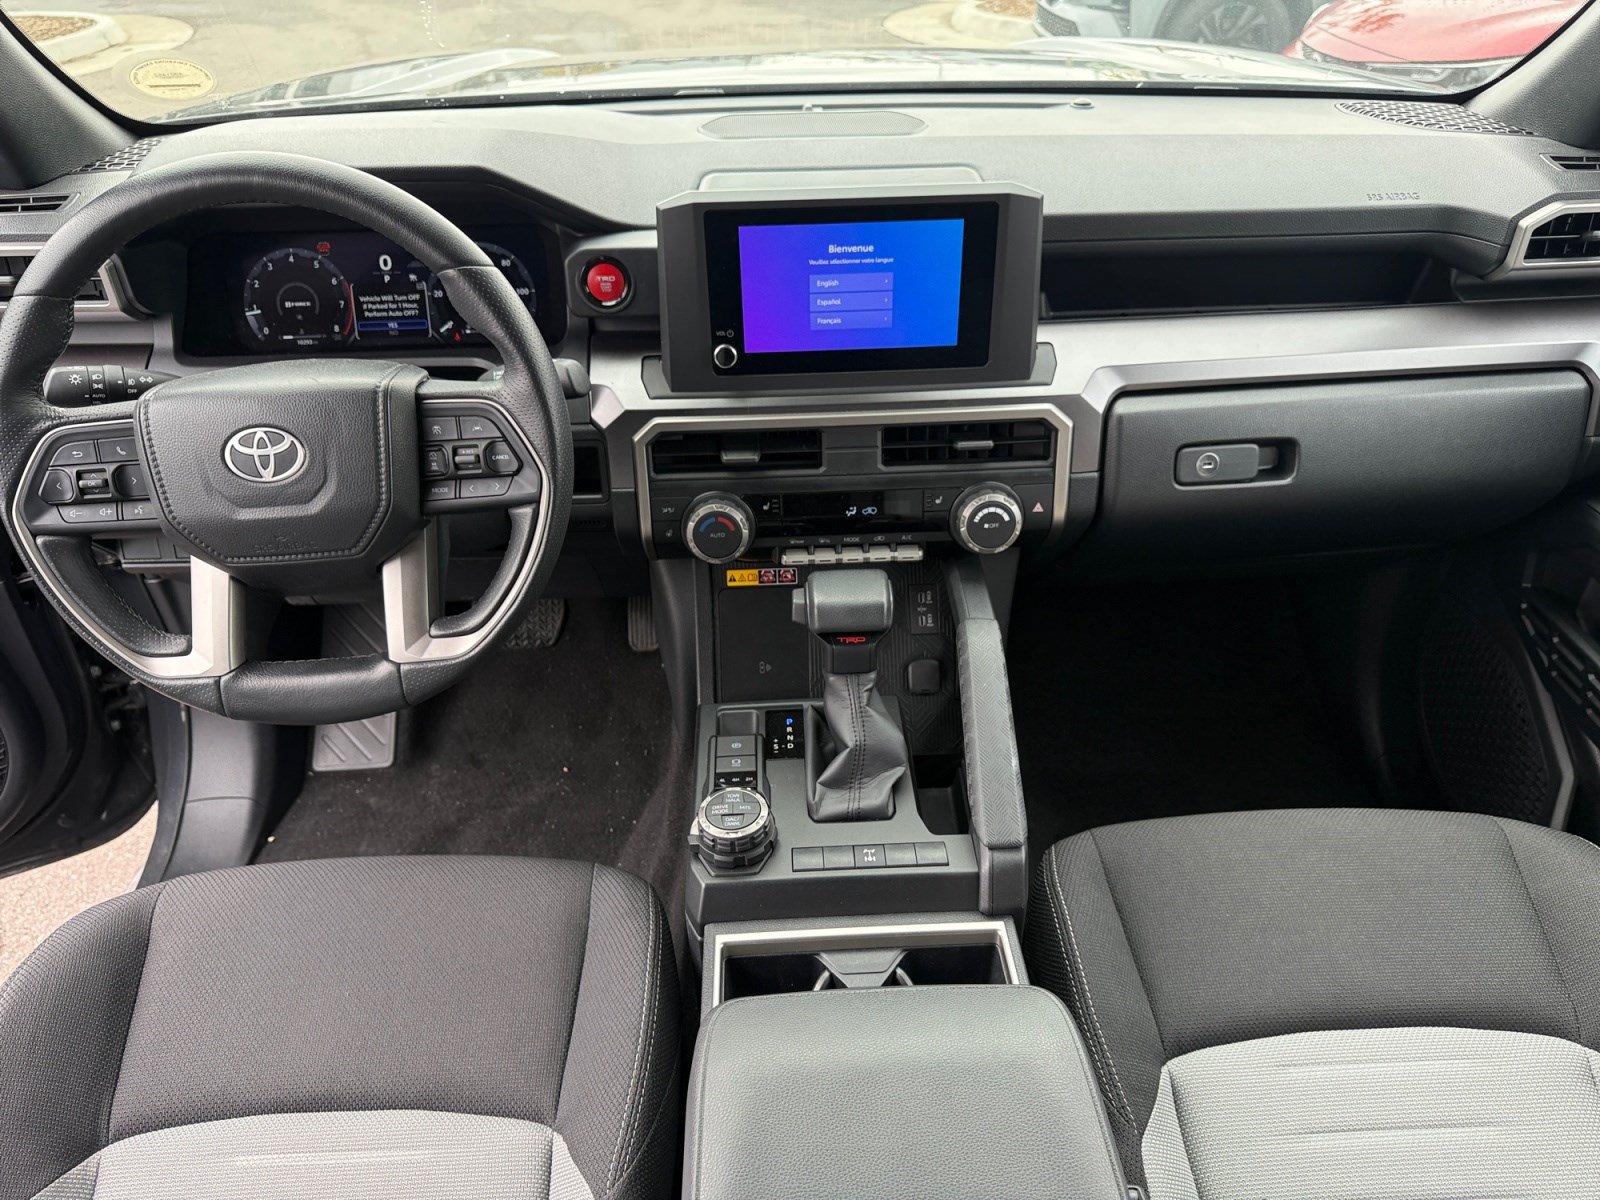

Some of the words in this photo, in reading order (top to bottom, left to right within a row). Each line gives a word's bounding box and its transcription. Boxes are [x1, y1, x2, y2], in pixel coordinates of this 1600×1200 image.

[828, 244, 875, 254] Bienvenue
[289, 254, 294, 263] 4
[379, 254, 392, 271] 0
[267, 263, 273, 271] 3
[314, 260, 320, 269] 5
[501, 259, 511, 267] 80
[332, 277, 338, 286] 6
[384, 275, 390, 283] P
[254, 280, 259, 288] 2
[816, 280, 839, 288] English
[433, 290, 443, 298] 20
[339, 300, 344, 309] 7
[816, 298, 841, 306] Español
[817, 317, 842, 325] Français
[263, 327, 269, 335] 0
[333, 324, 339, 333] 8
[836, 635, 867, 644] TRD
